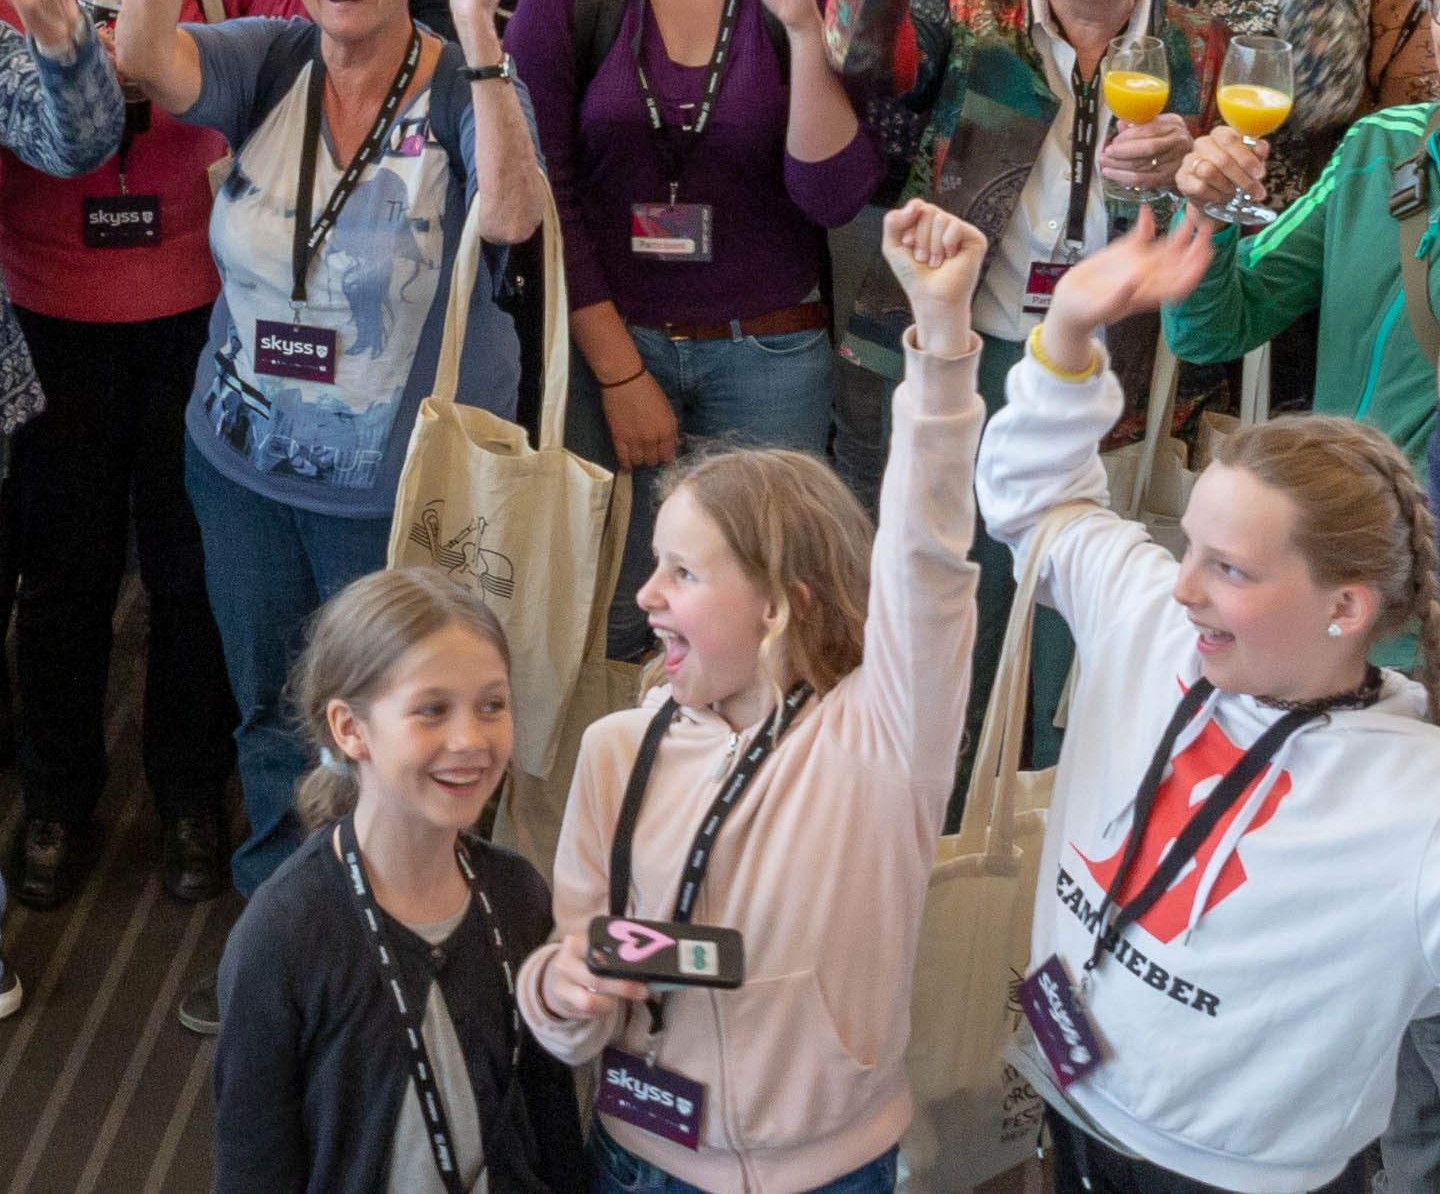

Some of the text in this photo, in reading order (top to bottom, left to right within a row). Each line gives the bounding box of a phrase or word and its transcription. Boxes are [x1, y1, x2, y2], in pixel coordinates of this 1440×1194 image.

[89, 209, 140, 227] skyss
[260, 334, 314, 356] skyss
[1056, 862, 1104, 935] EAM
[606, 1068, 676, 1108] skyss
